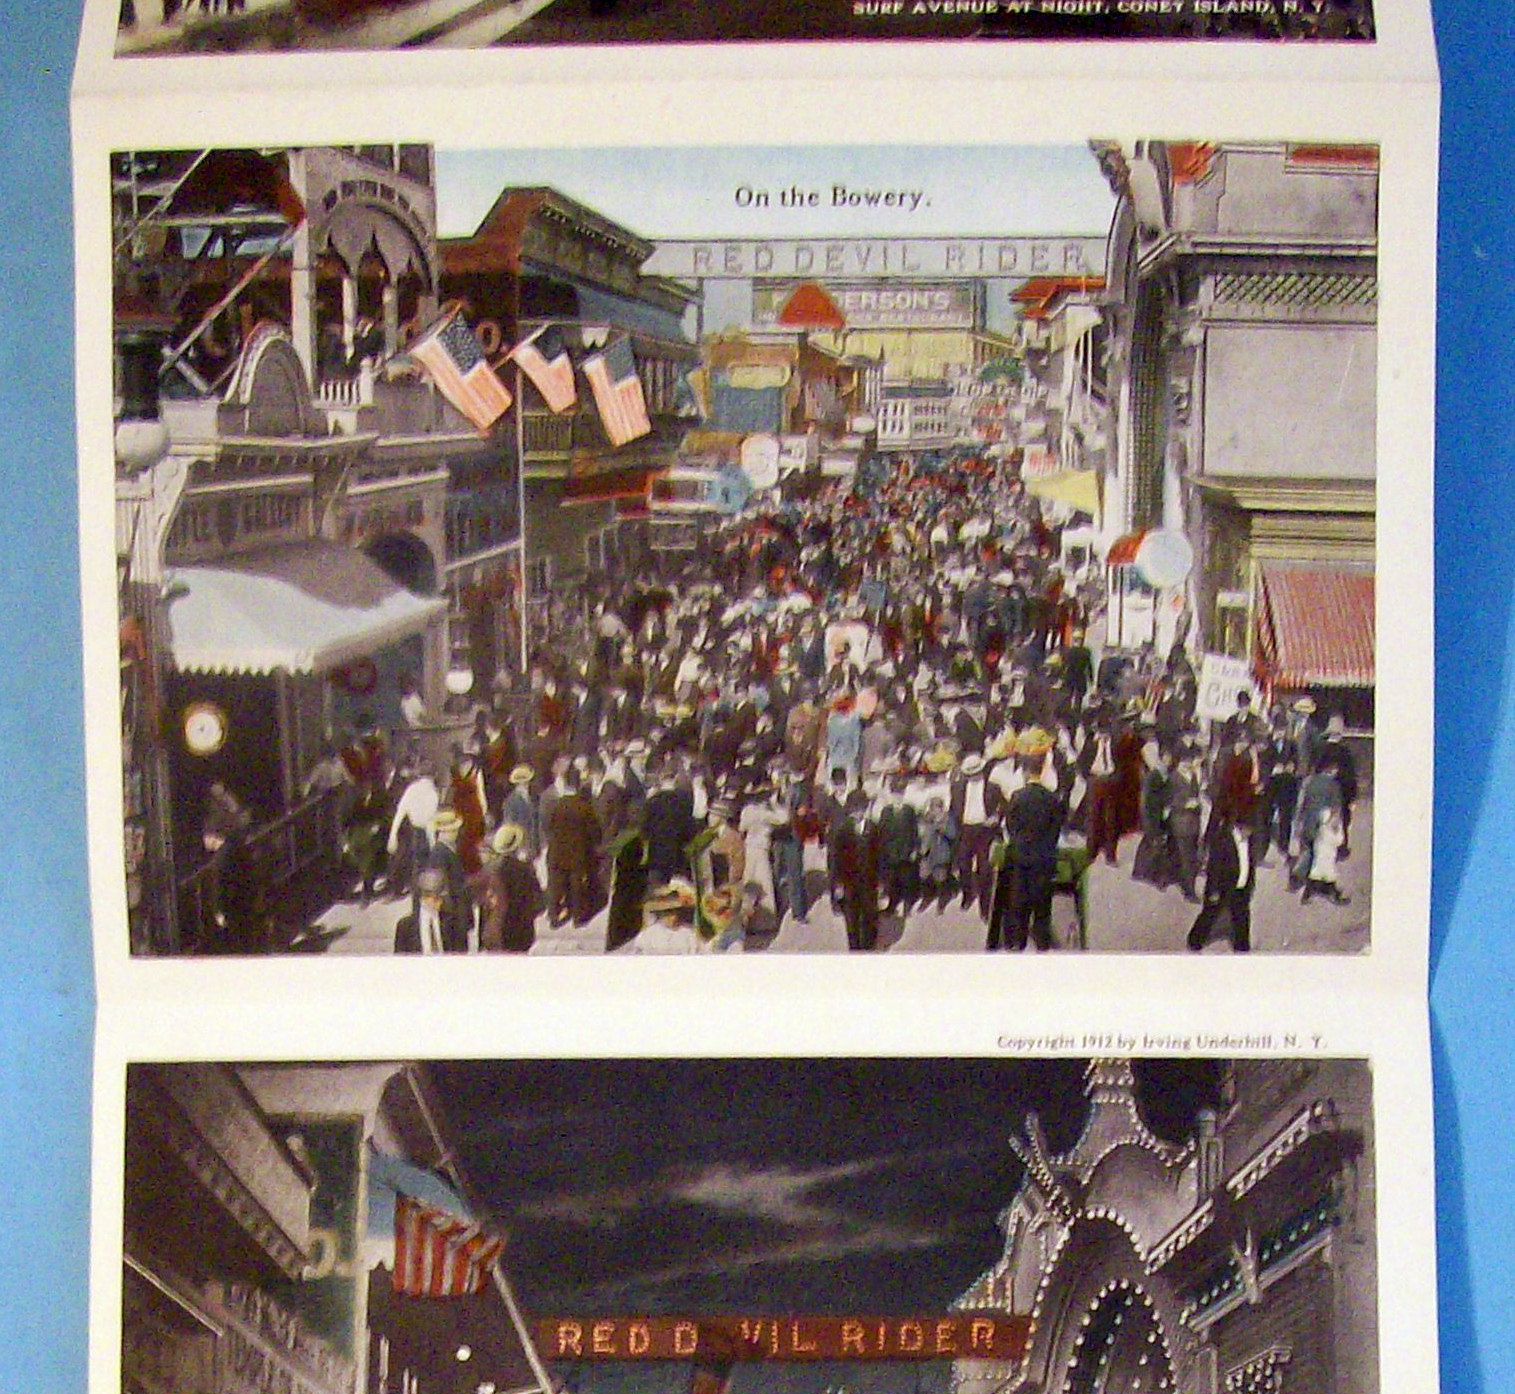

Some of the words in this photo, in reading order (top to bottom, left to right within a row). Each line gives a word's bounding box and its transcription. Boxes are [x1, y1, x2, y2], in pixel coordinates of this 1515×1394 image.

[853, 0, 900, 15] SURF
[911, 0, 998, 15] AVENUE
[1006, 0, 1031, 14] AT
[1117, 0, 1183, 14] CONEY
[734, 186, 770, 208] On
[780, 185, 821, 208] the
[831, 185, 932, 212] Bowery.
[692, 245, 775, 274] RED
[794, 244, 921, 273] DEVIL
[945, 240, 1090, 272] RIDER
[997, 1034, 1074, 1052] Copyright
[1081, 1034, 1112, 1050] 1912
[1117, 1034, 1136, 1052] by
[1143, 1034, 1190, 1051] Irving
[557, 1321, 650, 1356] RED
[840, 1316, 996, 1354] RIDER
